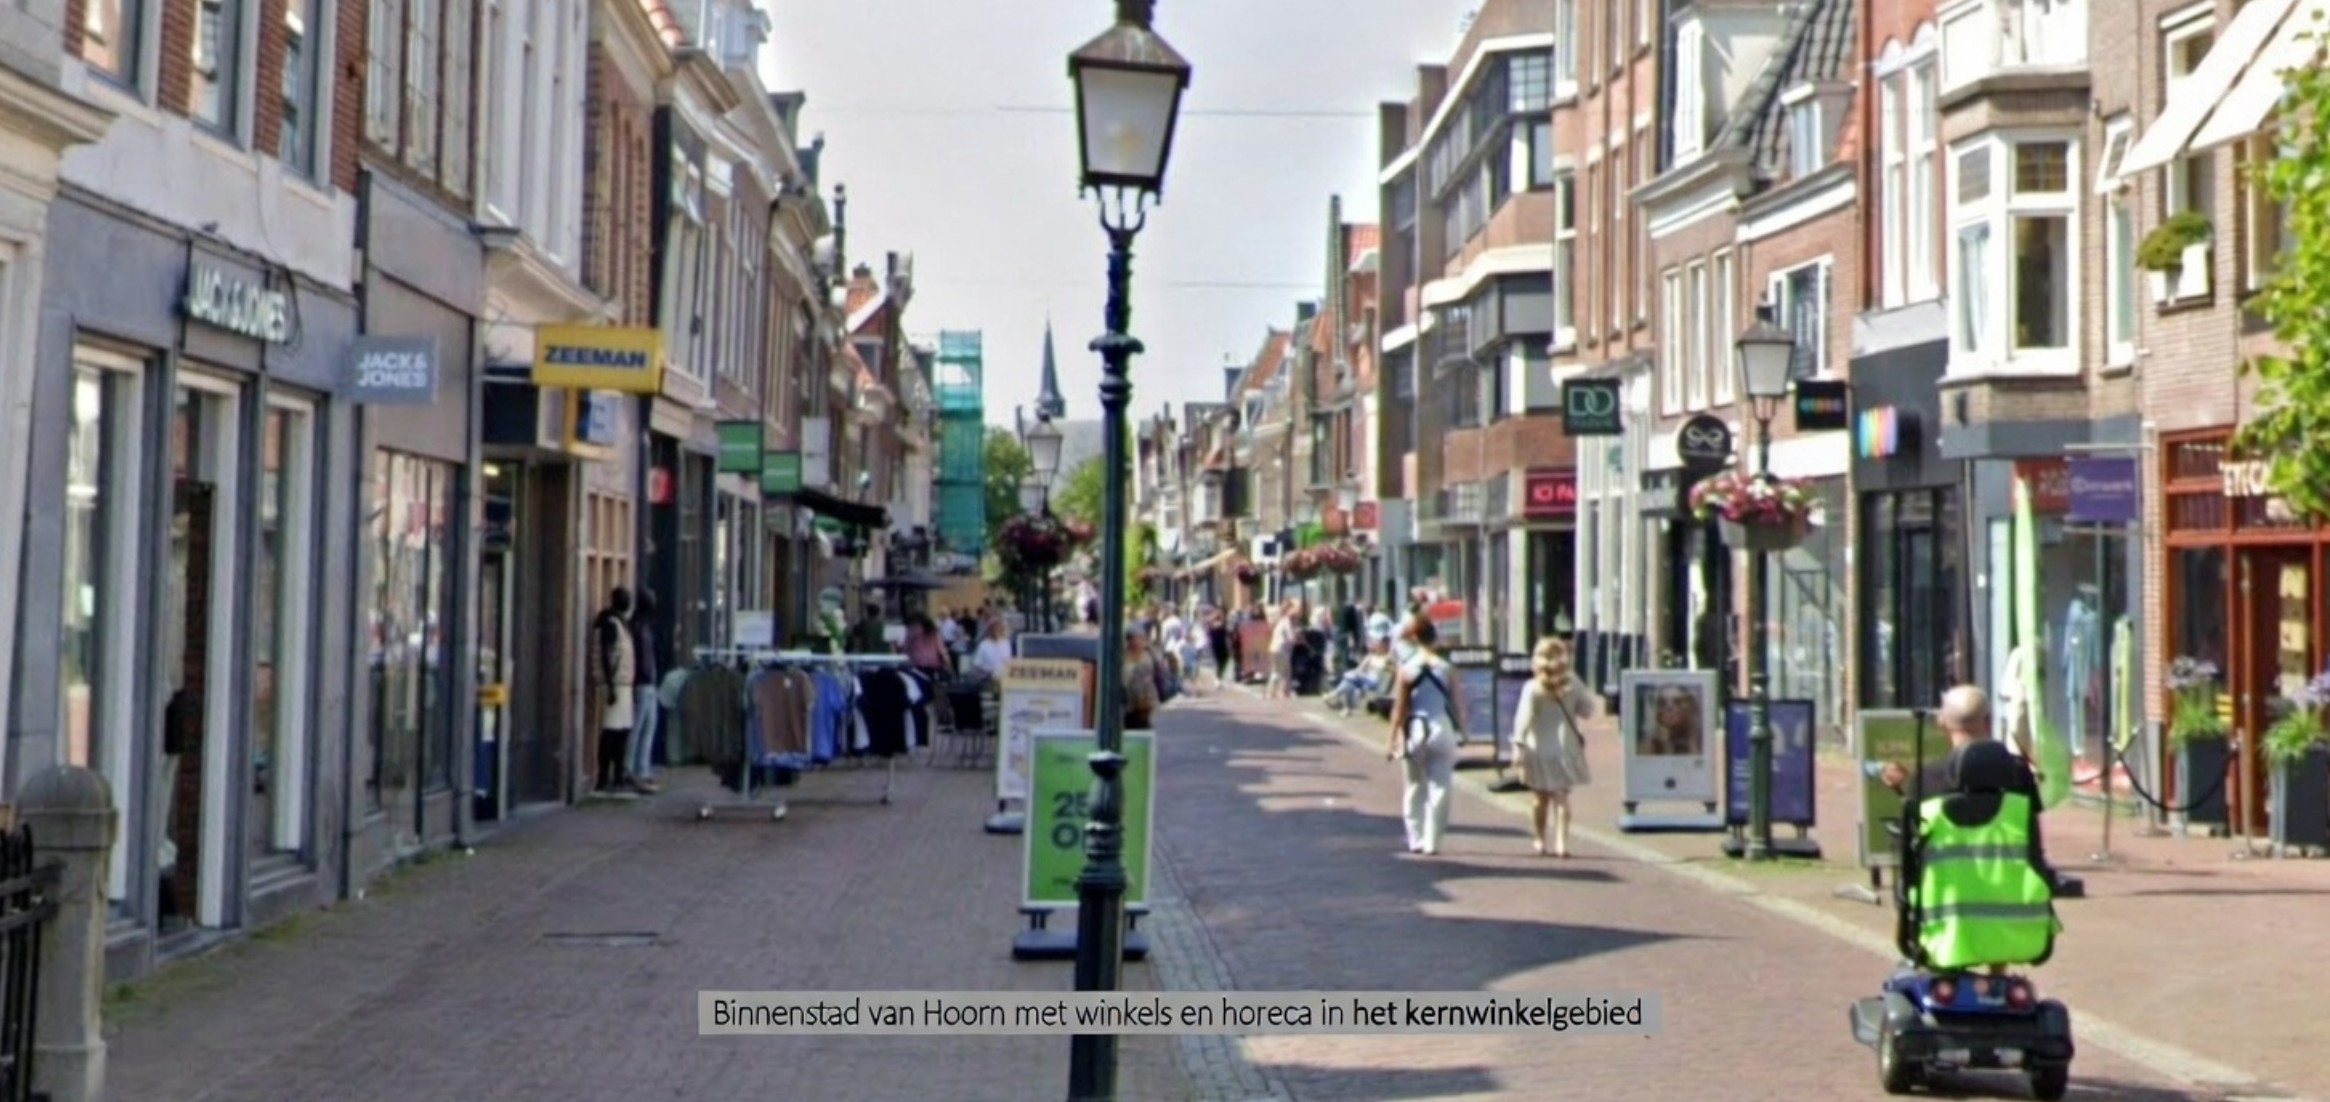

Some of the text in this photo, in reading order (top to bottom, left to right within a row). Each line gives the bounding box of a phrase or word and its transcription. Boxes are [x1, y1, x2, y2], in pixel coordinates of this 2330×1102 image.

[357, 352, 428, 370] JACK&
[545, 344, 647, 368] ZEEMAN
[357, 370, 428, 388] JONES
[1007, 664, 1079, 680] ZEEMAN
